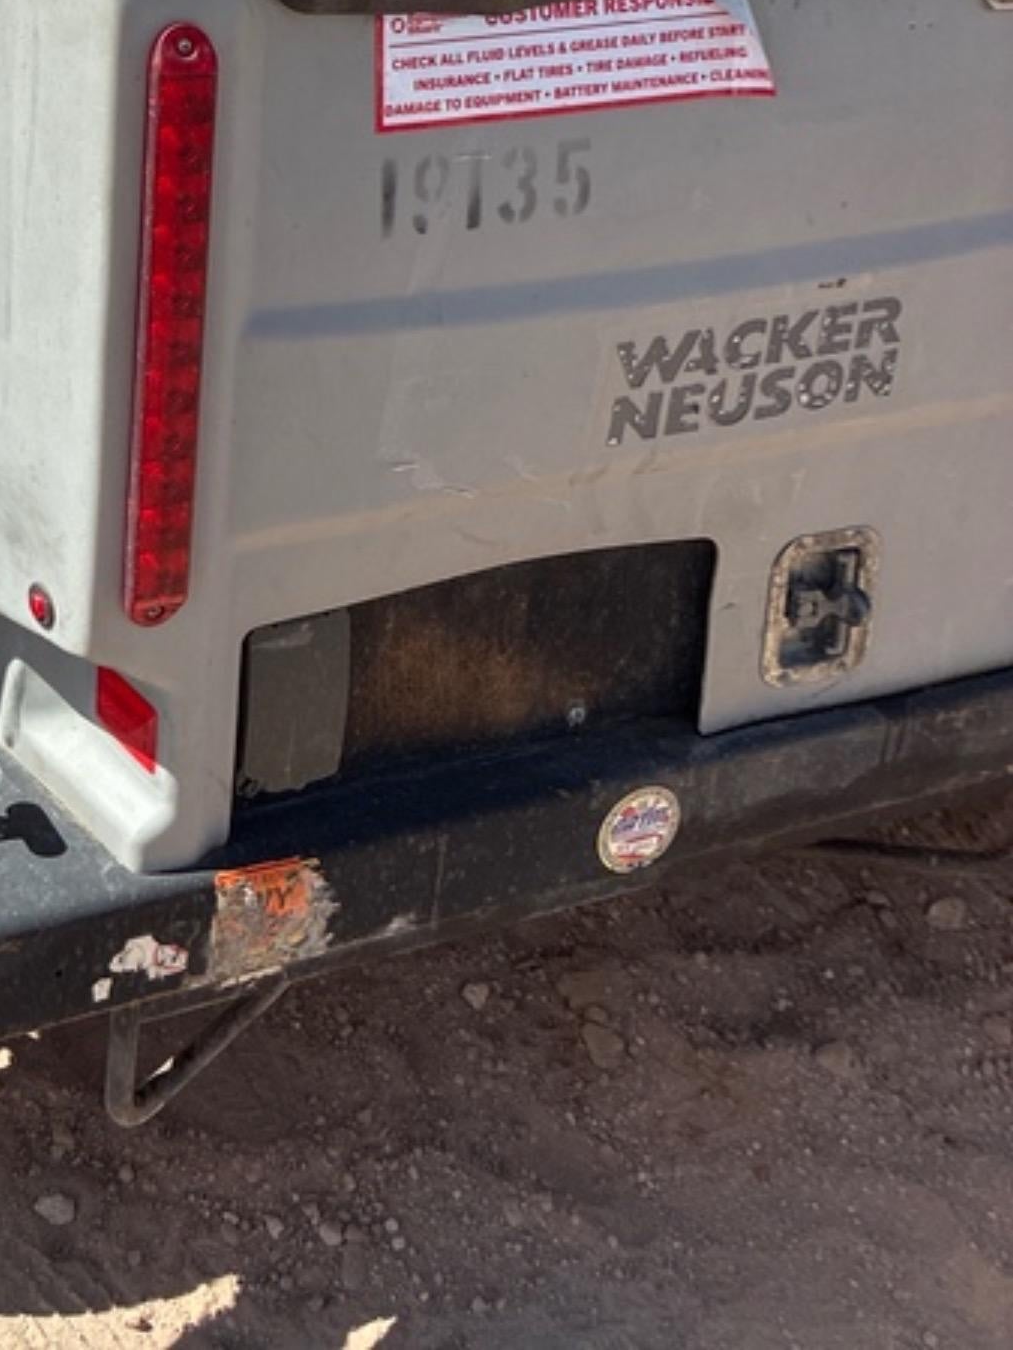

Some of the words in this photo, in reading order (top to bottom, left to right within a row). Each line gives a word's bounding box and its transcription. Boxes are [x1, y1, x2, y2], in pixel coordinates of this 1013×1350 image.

[391, 57, 437, 71] CHECK
[440, 53, 464, 66] ALL
[467, 50, 504, 64] FLUID
[508, 43, 556, 59] LEVELS
[559, 41, 567, 54] &
[569, 36, 618, 51] GREASE
[622, 32, 657, 48] DAILY
[660, 27, 705, 43] BEFORE
[708, 23, 745, 38] START
[413, 72, 491, 91] INSURANCE
[503, 67, 534, 82] FLAT
[538, 64, 573, 79] TIRES
[586, 58, 612, 73] TIRE
[617, 53, 668, 70] DAMAGE
[680, 47, 748, 63] REFUELING
[385, 100, 441, 118] DAMAGE
[445, 98, 462, 111] TO
[465, 90, 542, 109] EQUIPMENT
[554, 81, 609, 99] BATTERY
[611, 72, 698, 92] MAINTENANCE
[616, 296, 903, 390] WACKER
[606, 348, 899, 447] NEUSON
